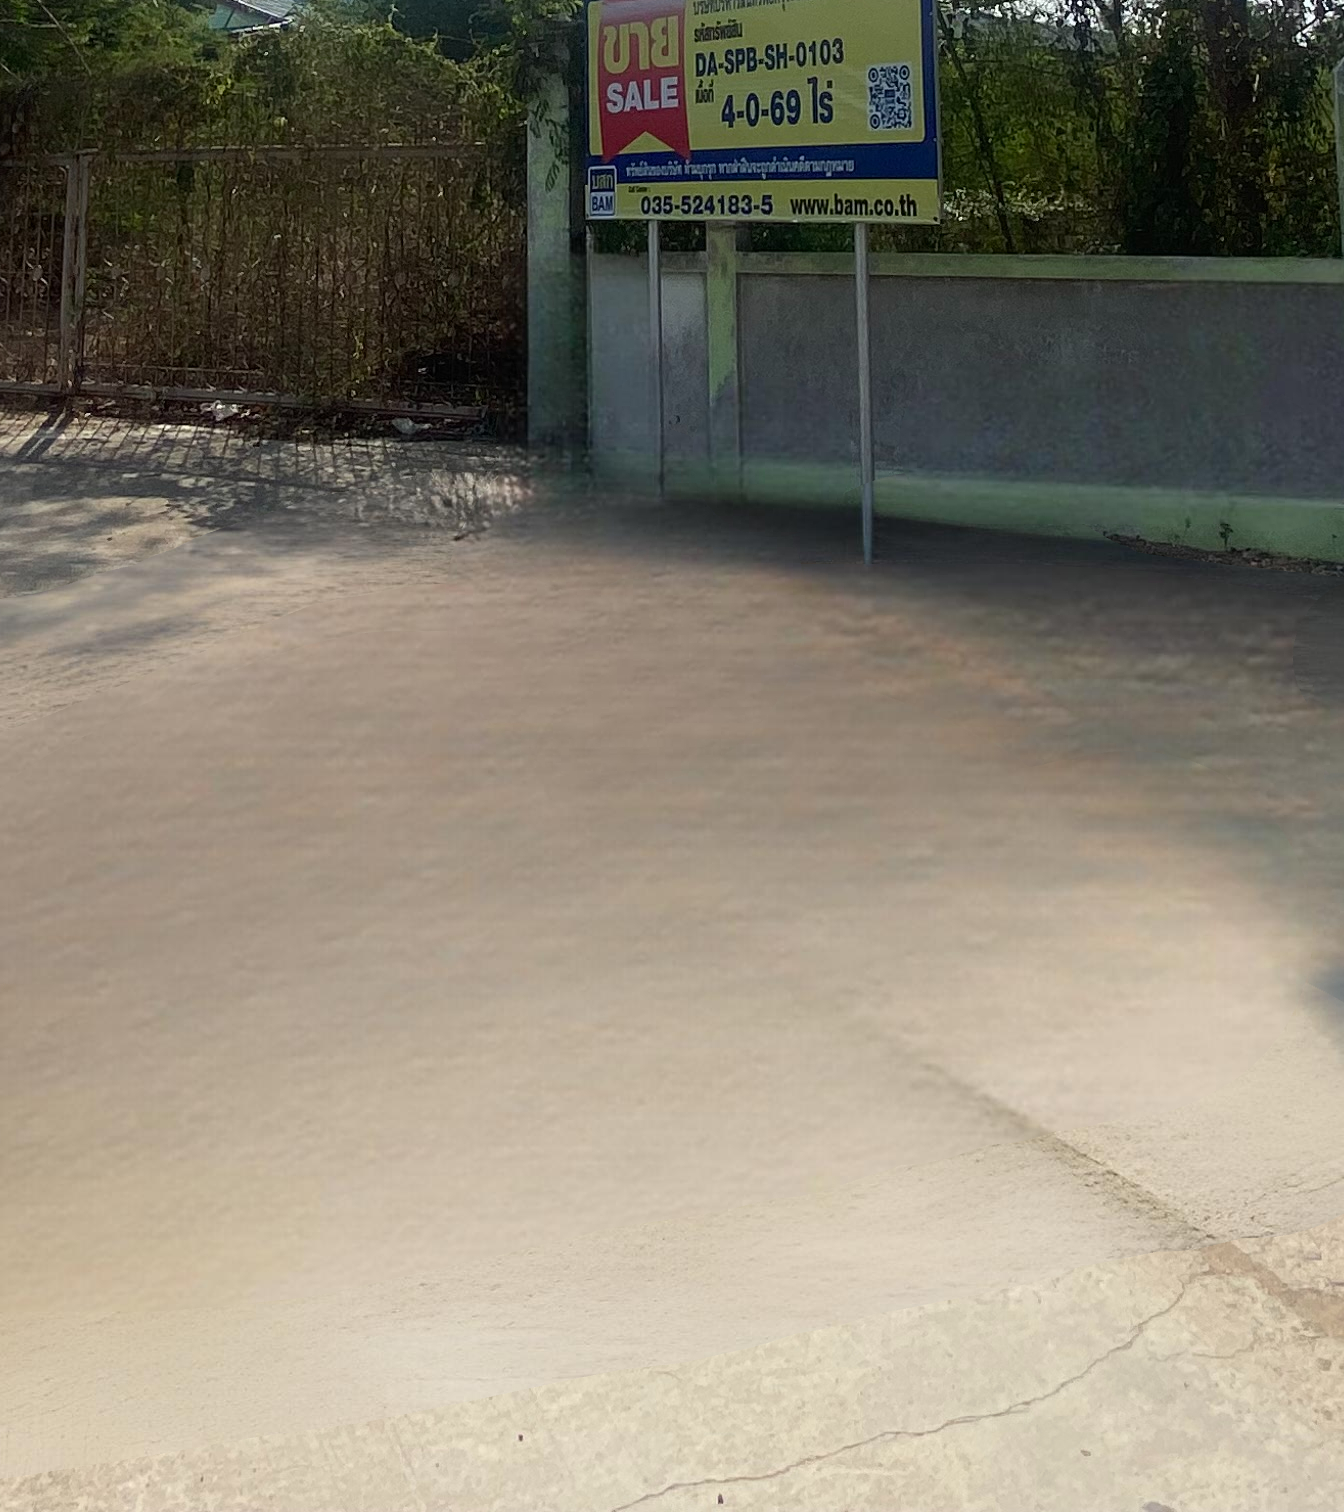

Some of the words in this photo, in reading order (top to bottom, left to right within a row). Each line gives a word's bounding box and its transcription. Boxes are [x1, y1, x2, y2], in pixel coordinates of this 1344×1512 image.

[603, 15, 680, 74] ขาย
[695, 38, 845, 77] DA-SPB-SH-0103
[606, 76, 679, 115] SALE
[721, 89, 801, 129] 4-0-69
[806, 76, 834, 125] ไร่
[591, 195, 613, 212] BAM
[641, 194, 774, 216] 035-524183-5
[790, 192, 918, 217] www.bam.co.th
